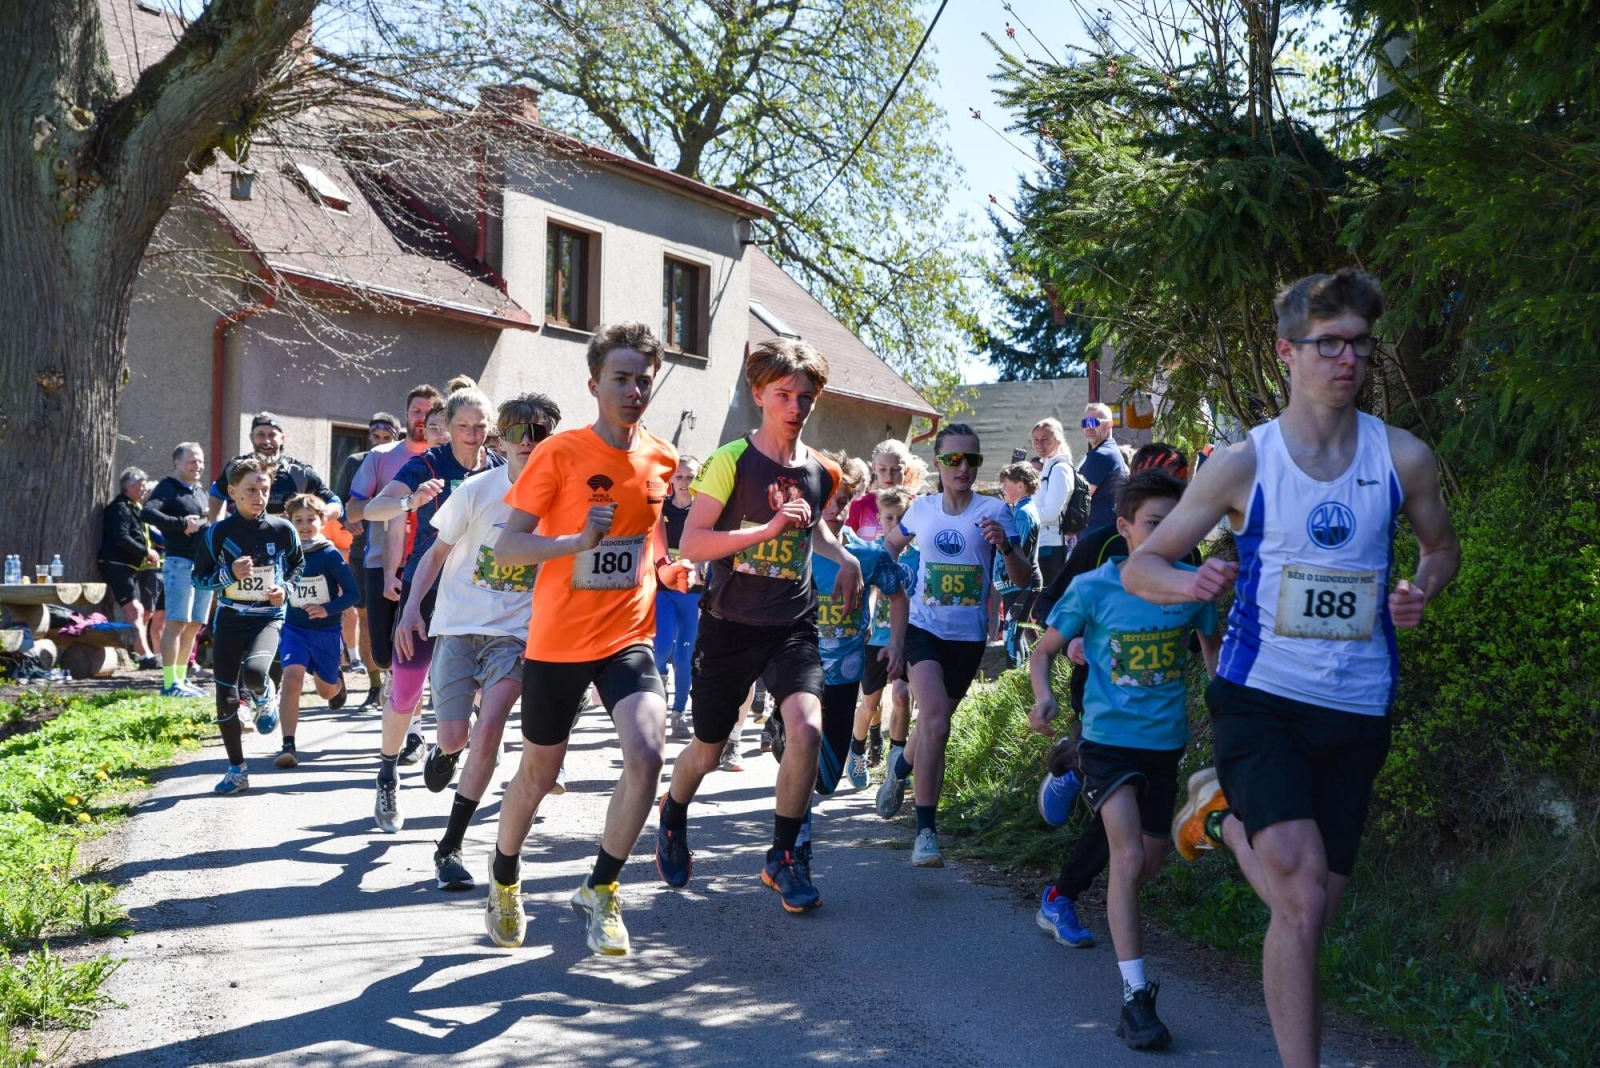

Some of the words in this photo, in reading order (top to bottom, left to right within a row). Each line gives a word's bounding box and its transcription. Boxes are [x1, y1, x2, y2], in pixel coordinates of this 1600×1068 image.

[752, 538, 794, 564] 115
[488, 560, 526, 582] 192
[592, 551, 633, 575] 180
[237, 577, 264, 592] 182
[941, 573, 965, 594] 85
[1307, 573, 1314, 581] O
[297, 585, 318, 599] 174
[1303, 588, 1357, 620] 188
[1129, 641, 1175, 670] 215
